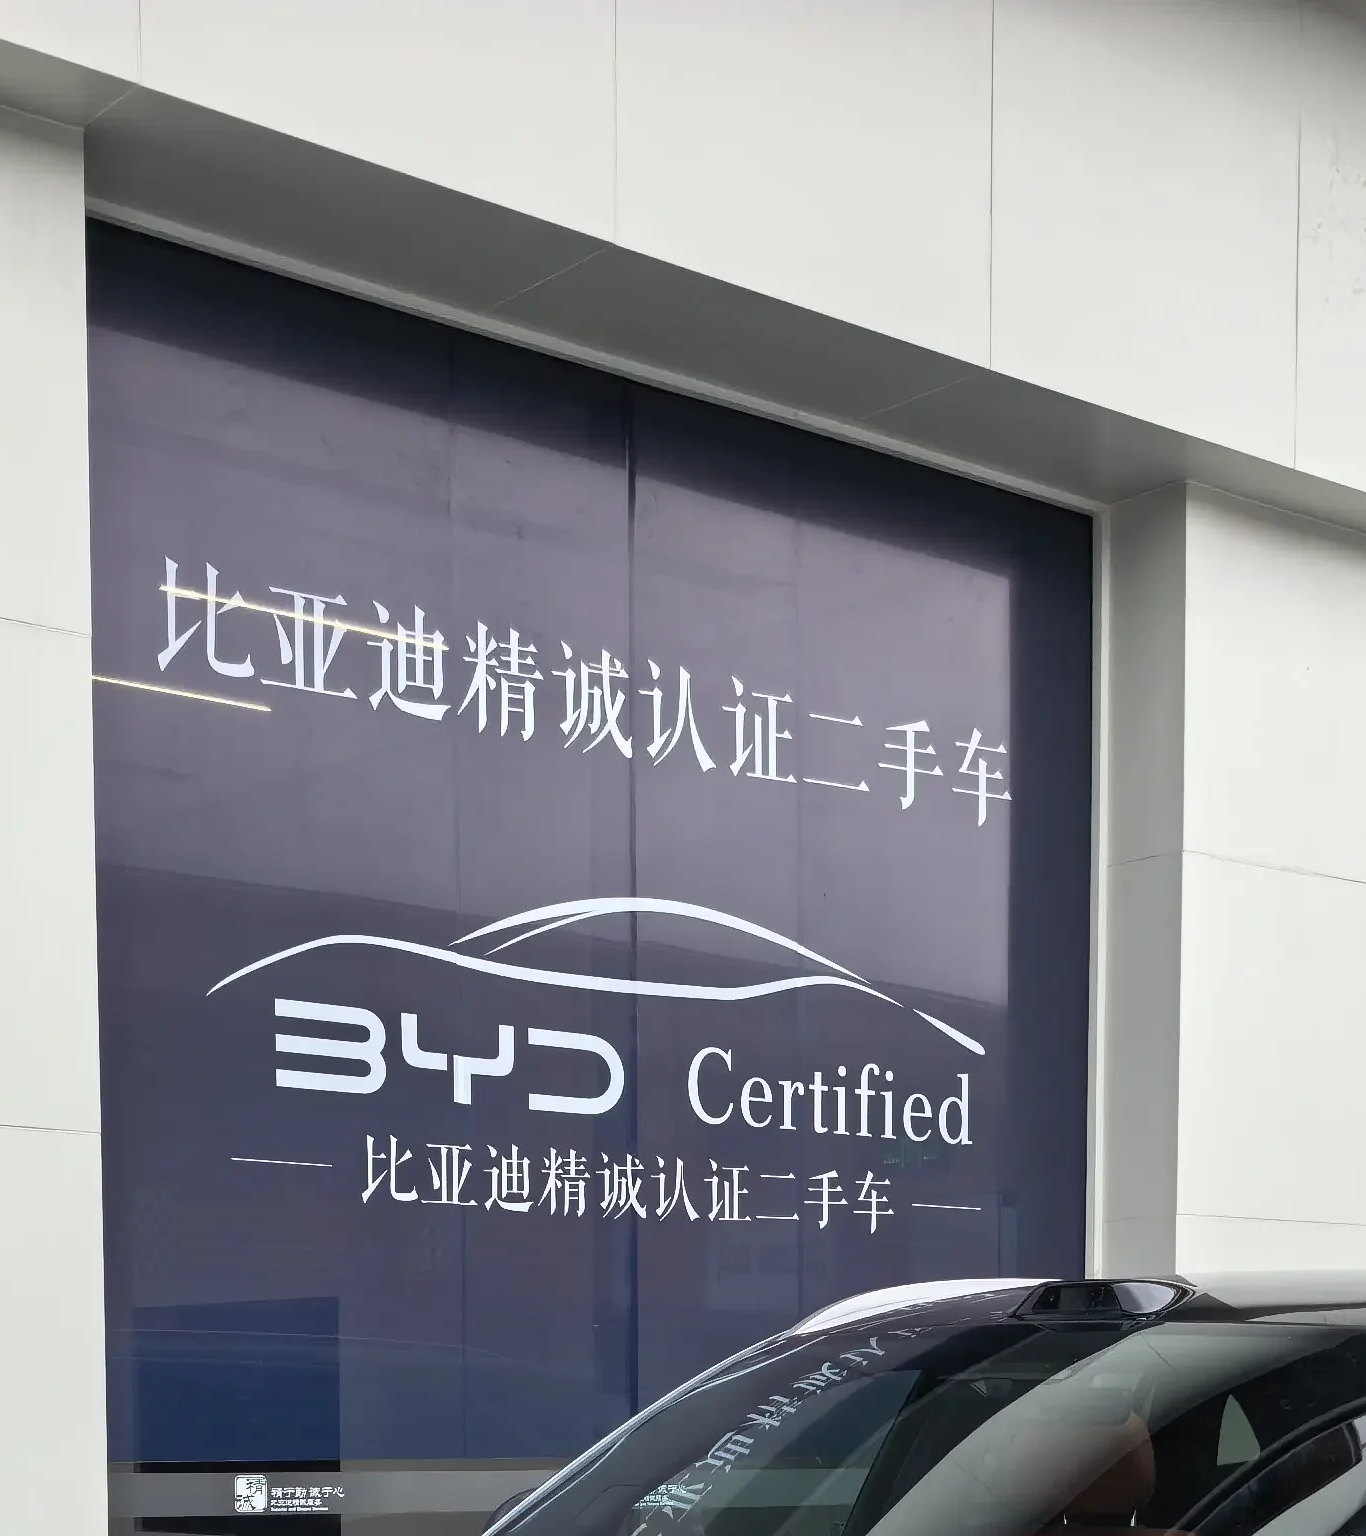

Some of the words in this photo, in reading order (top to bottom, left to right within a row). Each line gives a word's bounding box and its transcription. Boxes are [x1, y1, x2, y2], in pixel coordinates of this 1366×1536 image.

[157, 556, 1013, 828] 比亚迪精诚认证二手车
[275, 998, 625, 1115] BYD
[686, 1046, 974, 1147] Certified
[361, 1134, 895, 1235] 比亚迪精诚认证二手车
